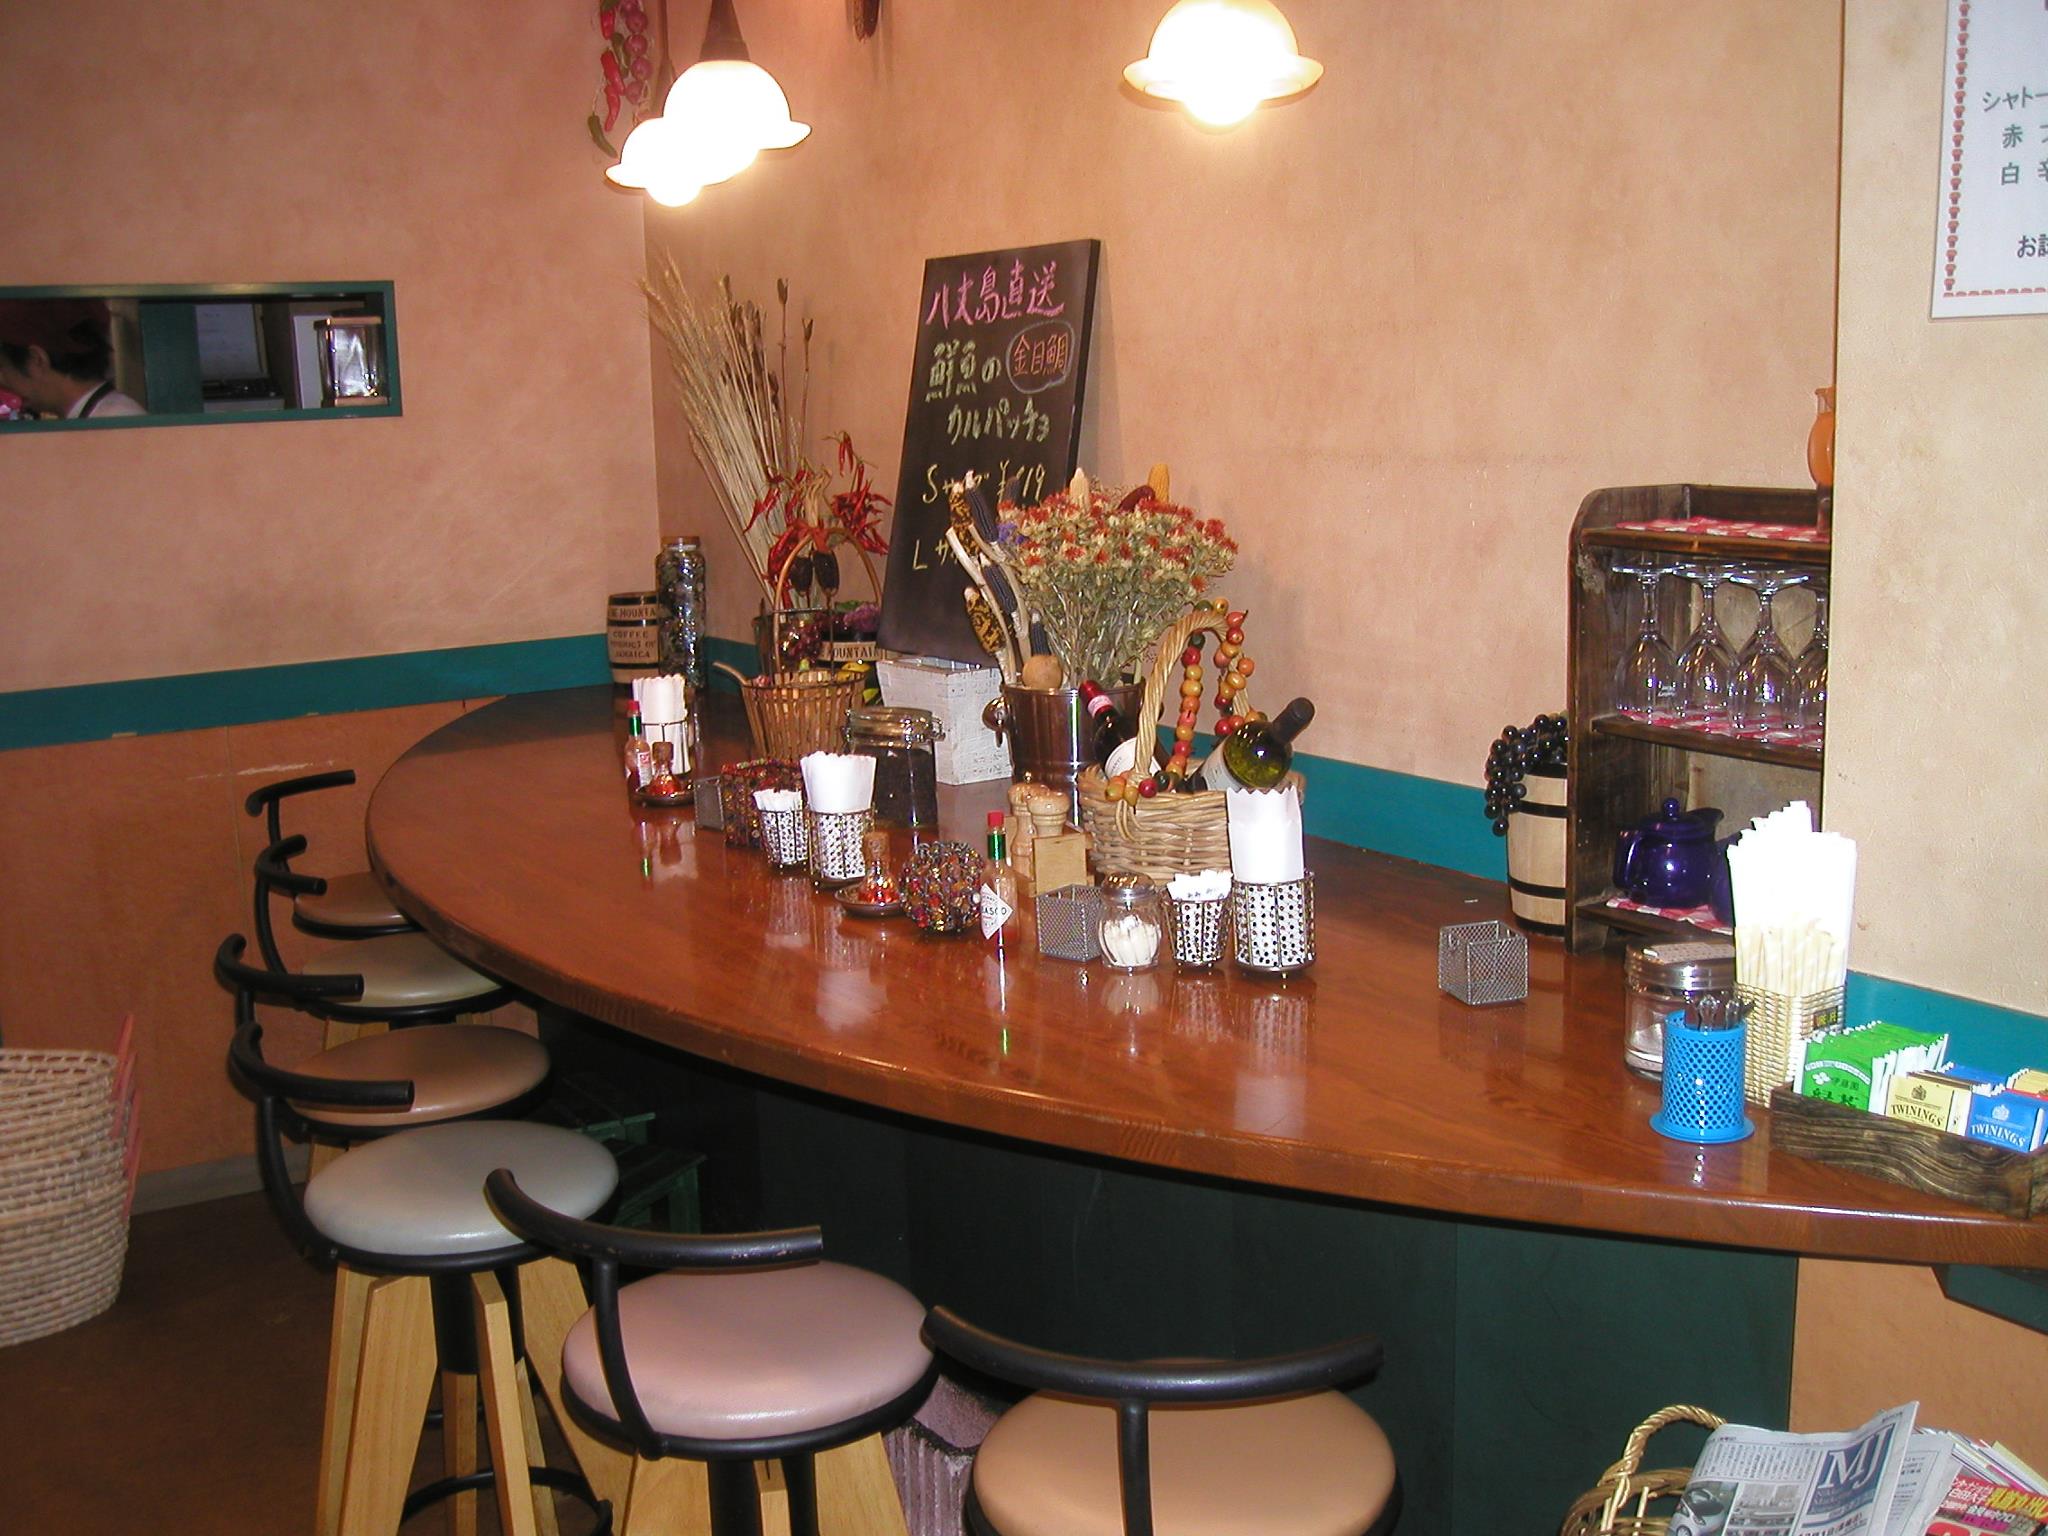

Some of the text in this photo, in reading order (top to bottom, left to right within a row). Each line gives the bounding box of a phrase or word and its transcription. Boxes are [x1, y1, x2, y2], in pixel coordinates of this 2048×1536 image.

[2002, 124, 2023, 148] 赤
[2001, 162, 2019, 186] 白
[925, 258, 1066, 328] 八丈島直送
[925, 339, 1001, 402] 鮮魚の
[947, 397, 1050, 445] カルパッチョ
[613, 630, 649, 639] COFFEE
[1890, 1103, 1943, 1127] TWININGS
[1970, 1123, 2027, 1147] TWININGS
[1817, 1424, 1893, 1489] MJ
